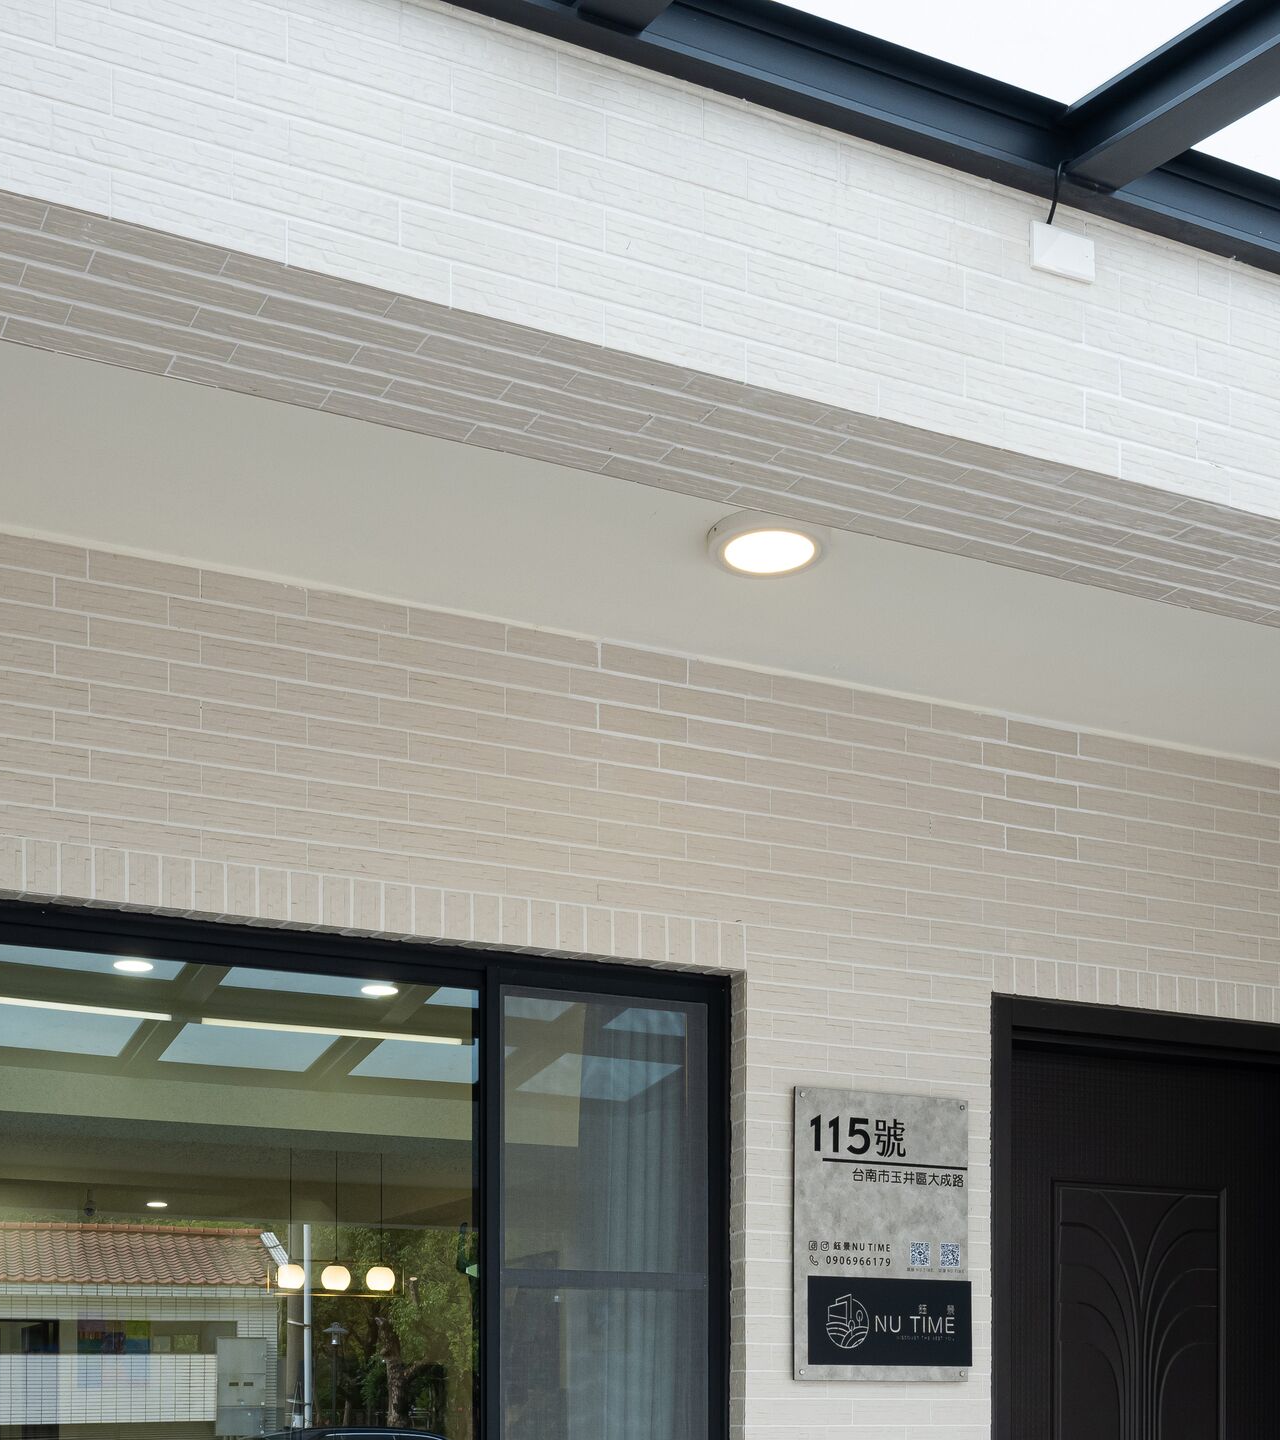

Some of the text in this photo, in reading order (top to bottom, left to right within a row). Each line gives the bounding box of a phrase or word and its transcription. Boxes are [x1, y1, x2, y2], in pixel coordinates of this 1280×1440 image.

[810, 1114, 907, 1158] 115號
[852, 1167, 964, 1188] 台南市玉井區大成路
[868, 1243, 891, 1253] TIME
[826, 1255, 891, 1267] 0906966179
[875, 1315, 956, 1334] NU TIME
